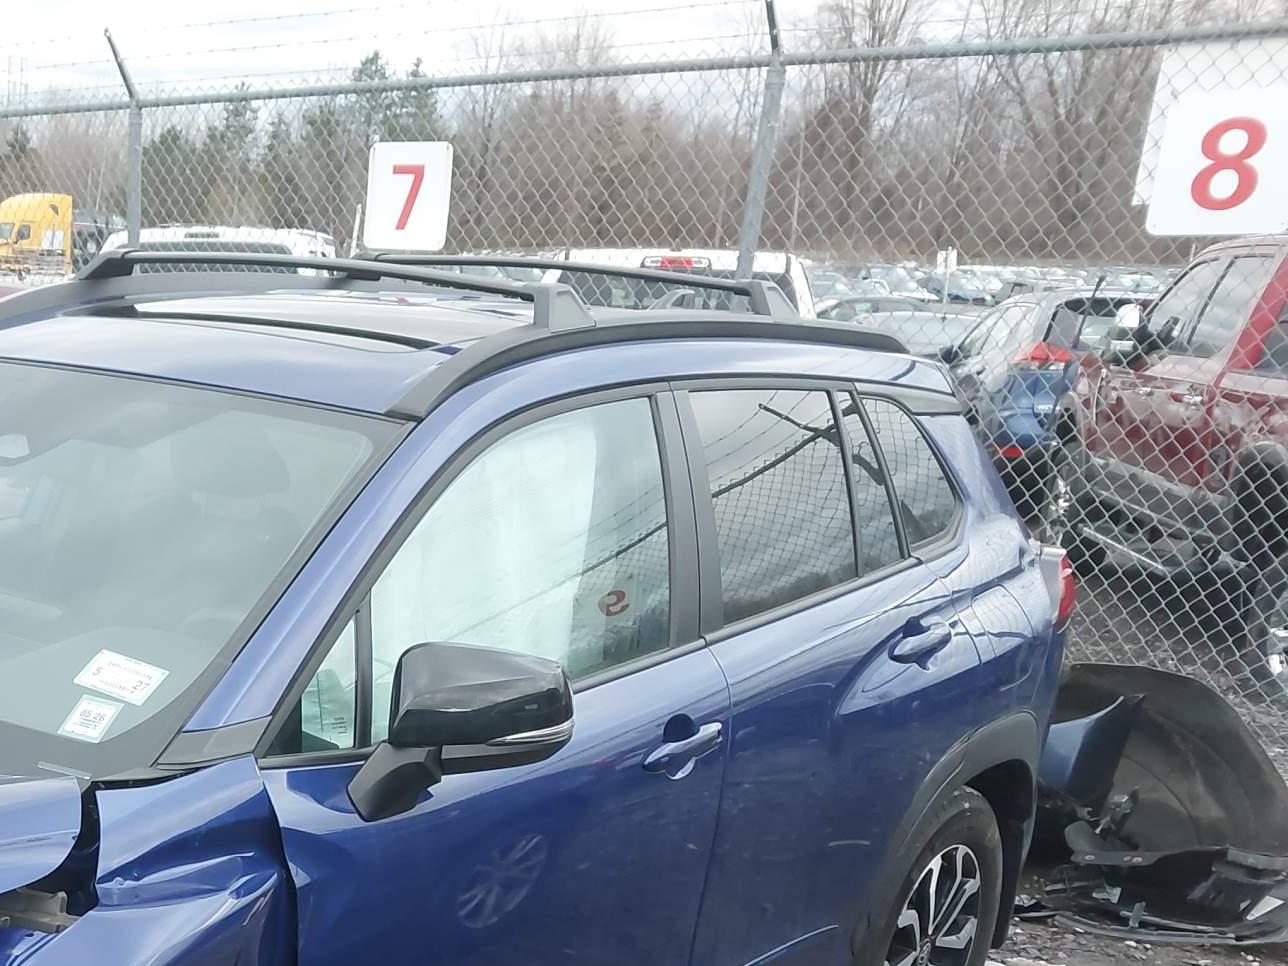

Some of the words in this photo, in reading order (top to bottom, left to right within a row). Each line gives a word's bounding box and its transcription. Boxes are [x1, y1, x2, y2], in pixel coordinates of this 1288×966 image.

[392, 164, 425, 231] 7
[1190, 116, 1268, 212] 8
[132, 680, 151, 692] 27
